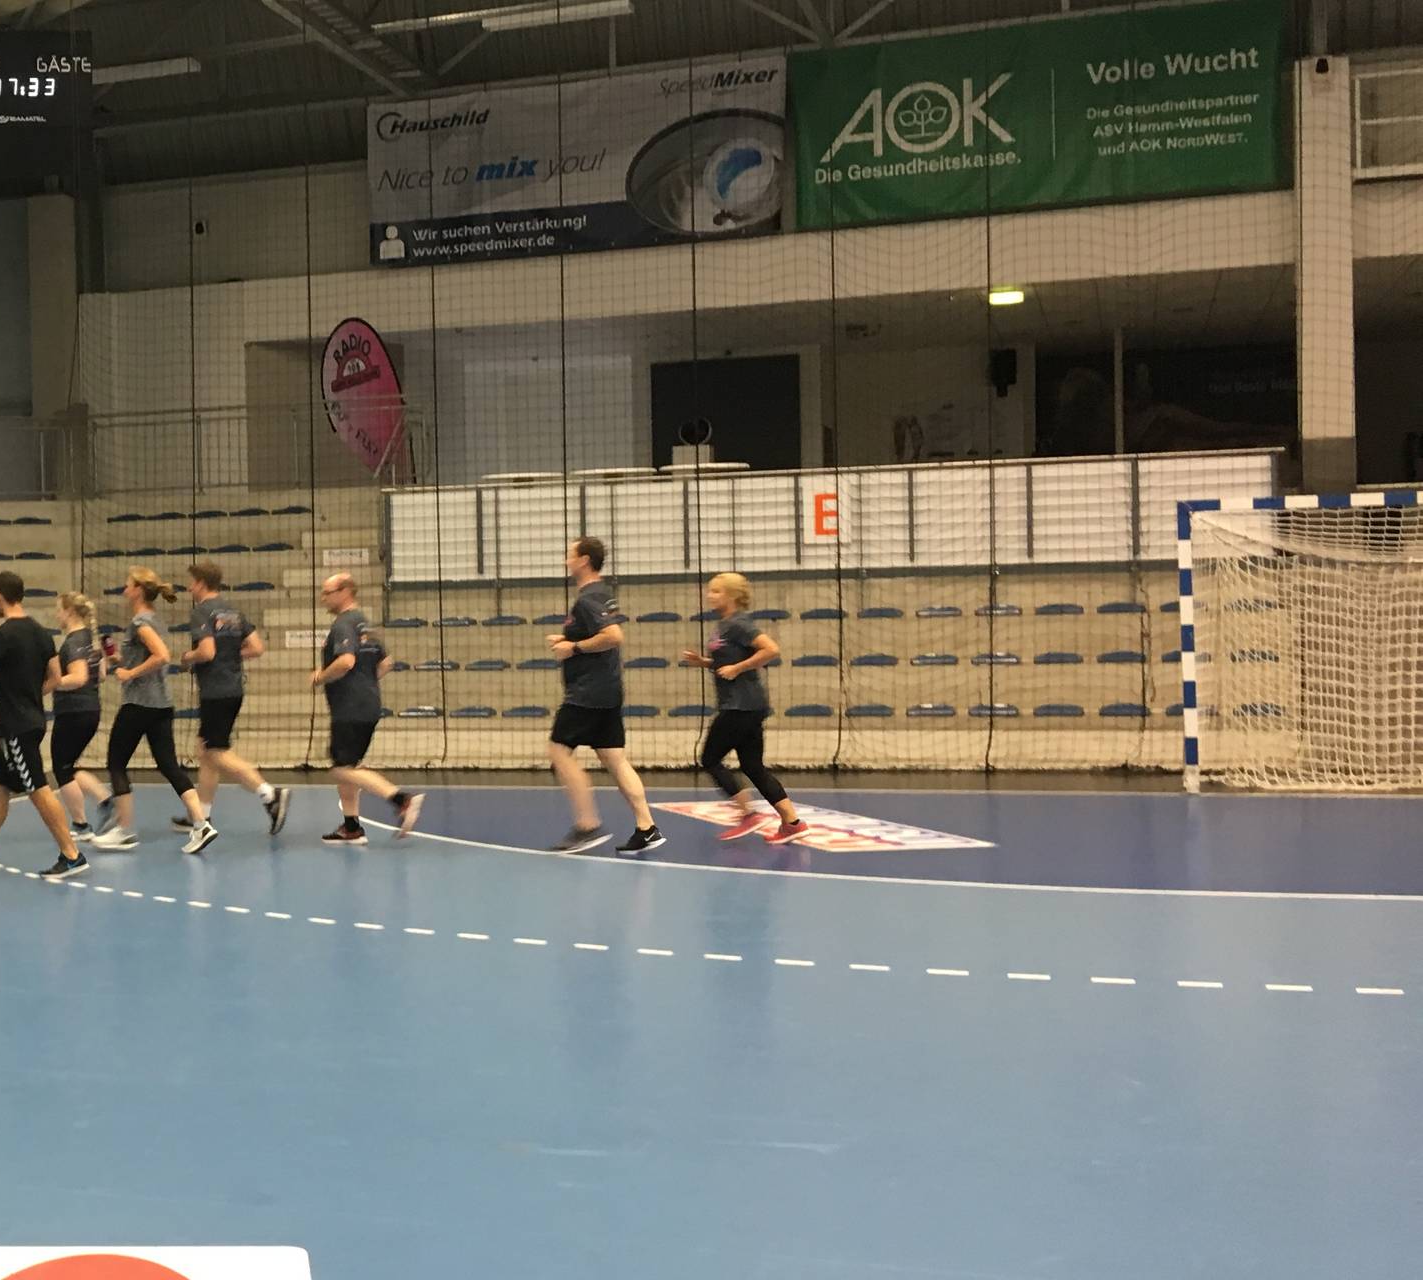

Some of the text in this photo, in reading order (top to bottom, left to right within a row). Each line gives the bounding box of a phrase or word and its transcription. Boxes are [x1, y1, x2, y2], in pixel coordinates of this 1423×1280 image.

[37, 55, 91, 73] GÄSTE
[1086, 47, 1259, 84] Volle Wucht
[658, 68, 779, 99] SpeedMixer
[820, 72, 1017, 163] AOK
[1087, 93, 1260, 120] Die Gesundheitspartner
[389, 110, 491, 135] Hauschild
[1093, 112, 1253, 138] ASV Hamm-Westfalen
[1098, 142, 1125, 156] und
[1129, 137, 1162, 152] AOK
[378, 148, 607, 193] Nice to mix you!
[815, 151, 1022, 185] Die Gesundheitskasse.
[413, 216, 588, 242] Wir suchen Verstärkung!
[412, 236, 556, 257] www.speedmixer.de
[333, 334, 371, 366] RADIO
[815, 493, 838, 536] E
